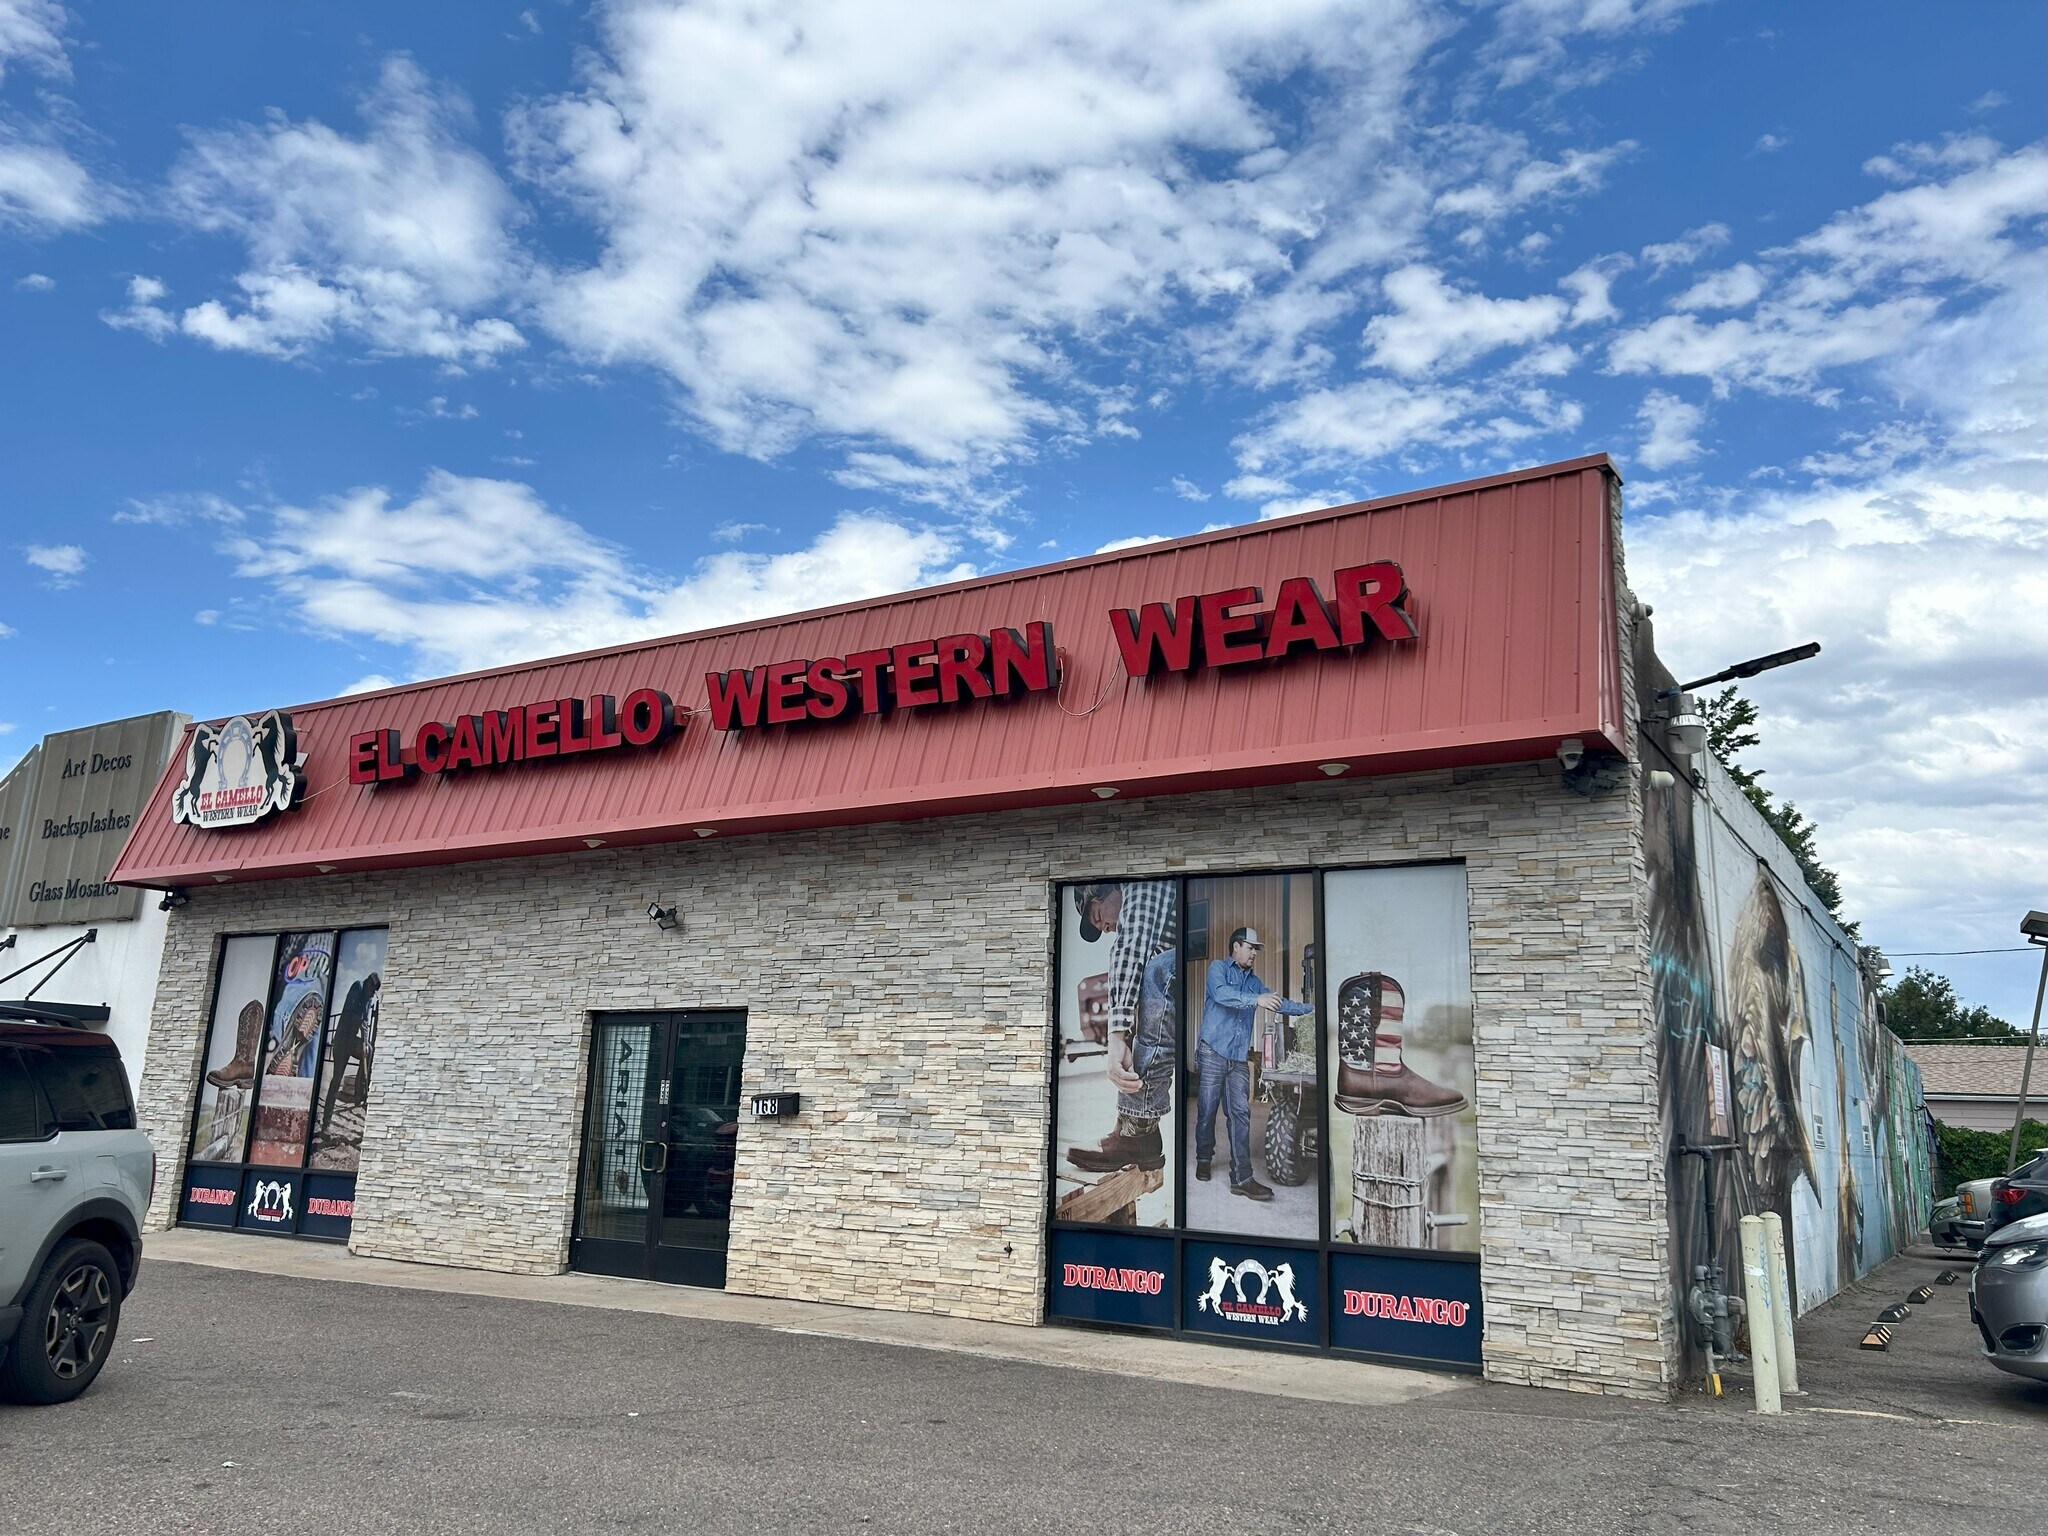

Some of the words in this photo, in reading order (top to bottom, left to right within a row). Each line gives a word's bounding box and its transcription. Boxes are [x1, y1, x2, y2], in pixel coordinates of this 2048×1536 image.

[350, 728, 403, 784] EL
[415, 688, 673, 773] CAMELLO
[706, 621, 1057, 731] WESTERN
[1109, 560, 1418, 677] WEAR
[61, 758, 86, 779] Art
[90, 753, 132, 774] Decos
[200, 792, 212, 810] EL
[215, 785, 263, 809] CAMELLO
[41, 809, 131, 840] Backsplashes
[203, 807, 234, 821] WESTERN
[237, 804, 258, 818] WEAR
[29, 880, 63, 902] Glass
[64, 876, 119, 899] Mosaics
[615, 1037, 633, 1165] ARIAT
[754, 1099, 777, 1115] 168
[190, 1187, 235, 1205] DURANGO
[1063, 1263, 1163, 1296] DURANGO
[1222, 1301, 1233, 1312] EL
[1236, 1303, 1281, 1317] CAMELLO
[1225, 1312, 1257, 1323] WESTERN
[1258, 1315, 1279, 1326] WEAR
[1344, 1289, 1468, 1328] DURANGO
